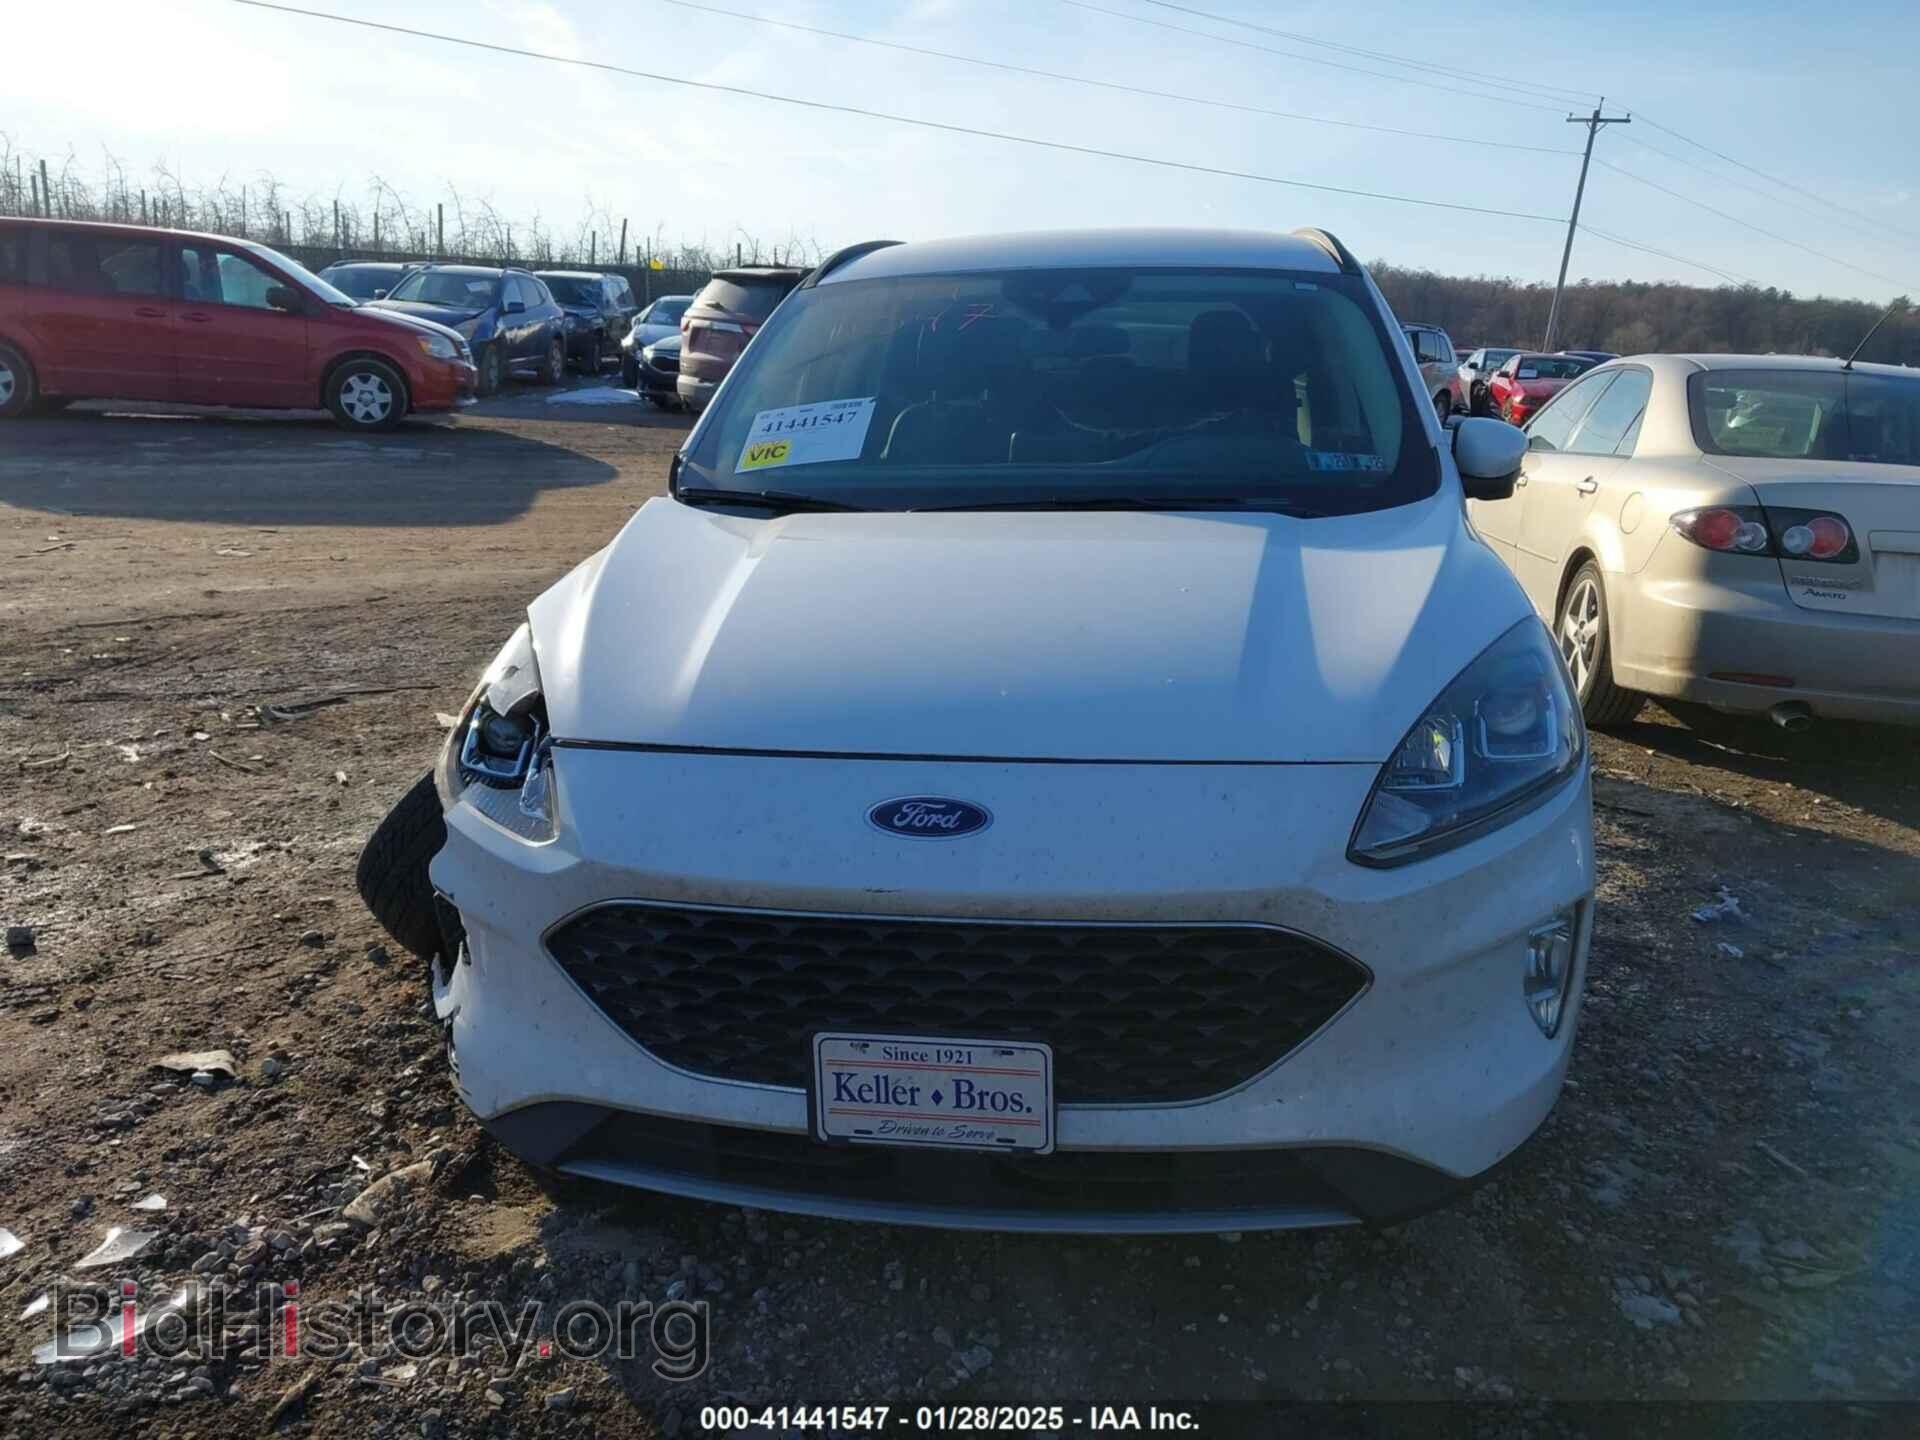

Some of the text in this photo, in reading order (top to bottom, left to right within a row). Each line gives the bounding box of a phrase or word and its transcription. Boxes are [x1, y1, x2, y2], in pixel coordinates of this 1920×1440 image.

[762, 411, 857, 433] 41441547
[750, 445, 786, 462] VIC
[893, 801, 963, 829] Ford
[882, 1046, 973, 1065] Since 1921
[832, 1071, 1033, 1114] Keller Bros.
[878, 1119, 930, 1137] Driven
[948, 1124, 995, 1140] Serve
